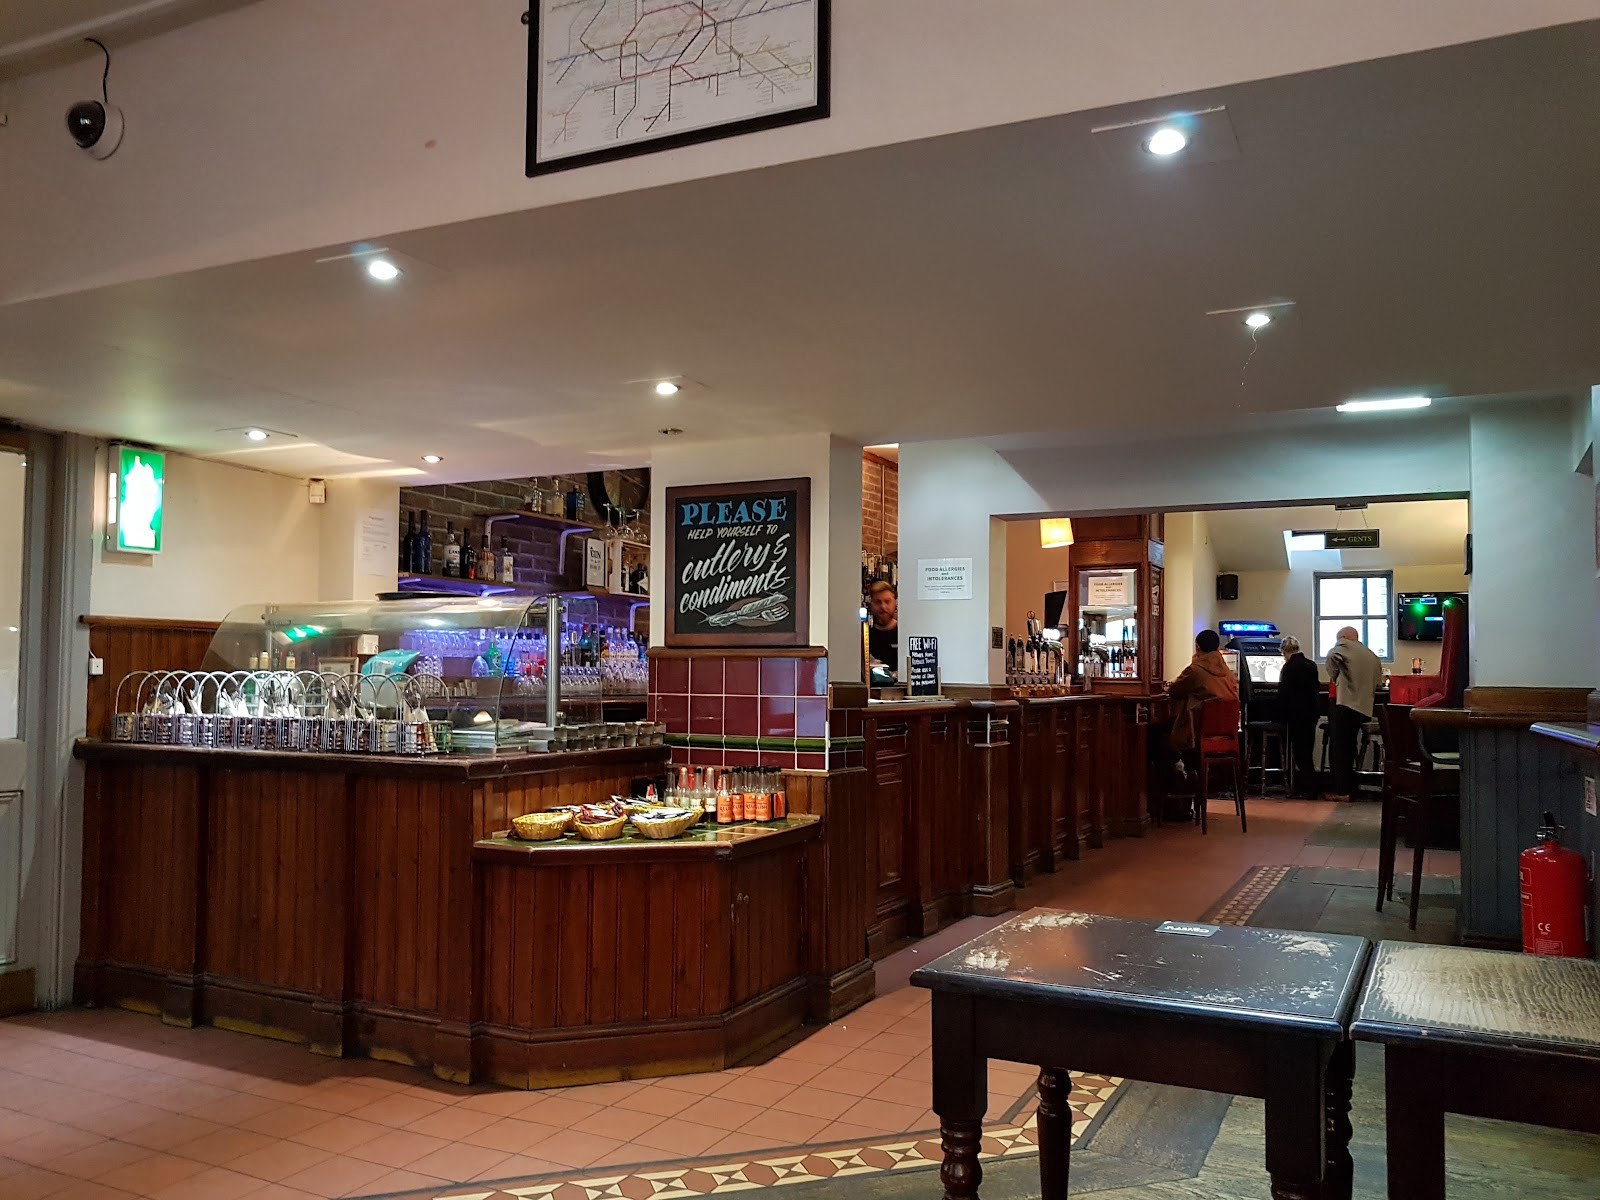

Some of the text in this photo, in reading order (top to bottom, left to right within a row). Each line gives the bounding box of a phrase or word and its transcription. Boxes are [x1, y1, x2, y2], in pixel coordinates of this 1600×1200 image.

[681, 497, 787, 526] PLEASE
[687, 524, 778, 540] HELP YOURSELF TO
[681, 539, 771, 585] cutlery
[679, 562, 791, 614] condiments
[910, 637, 922, 650] FREE
